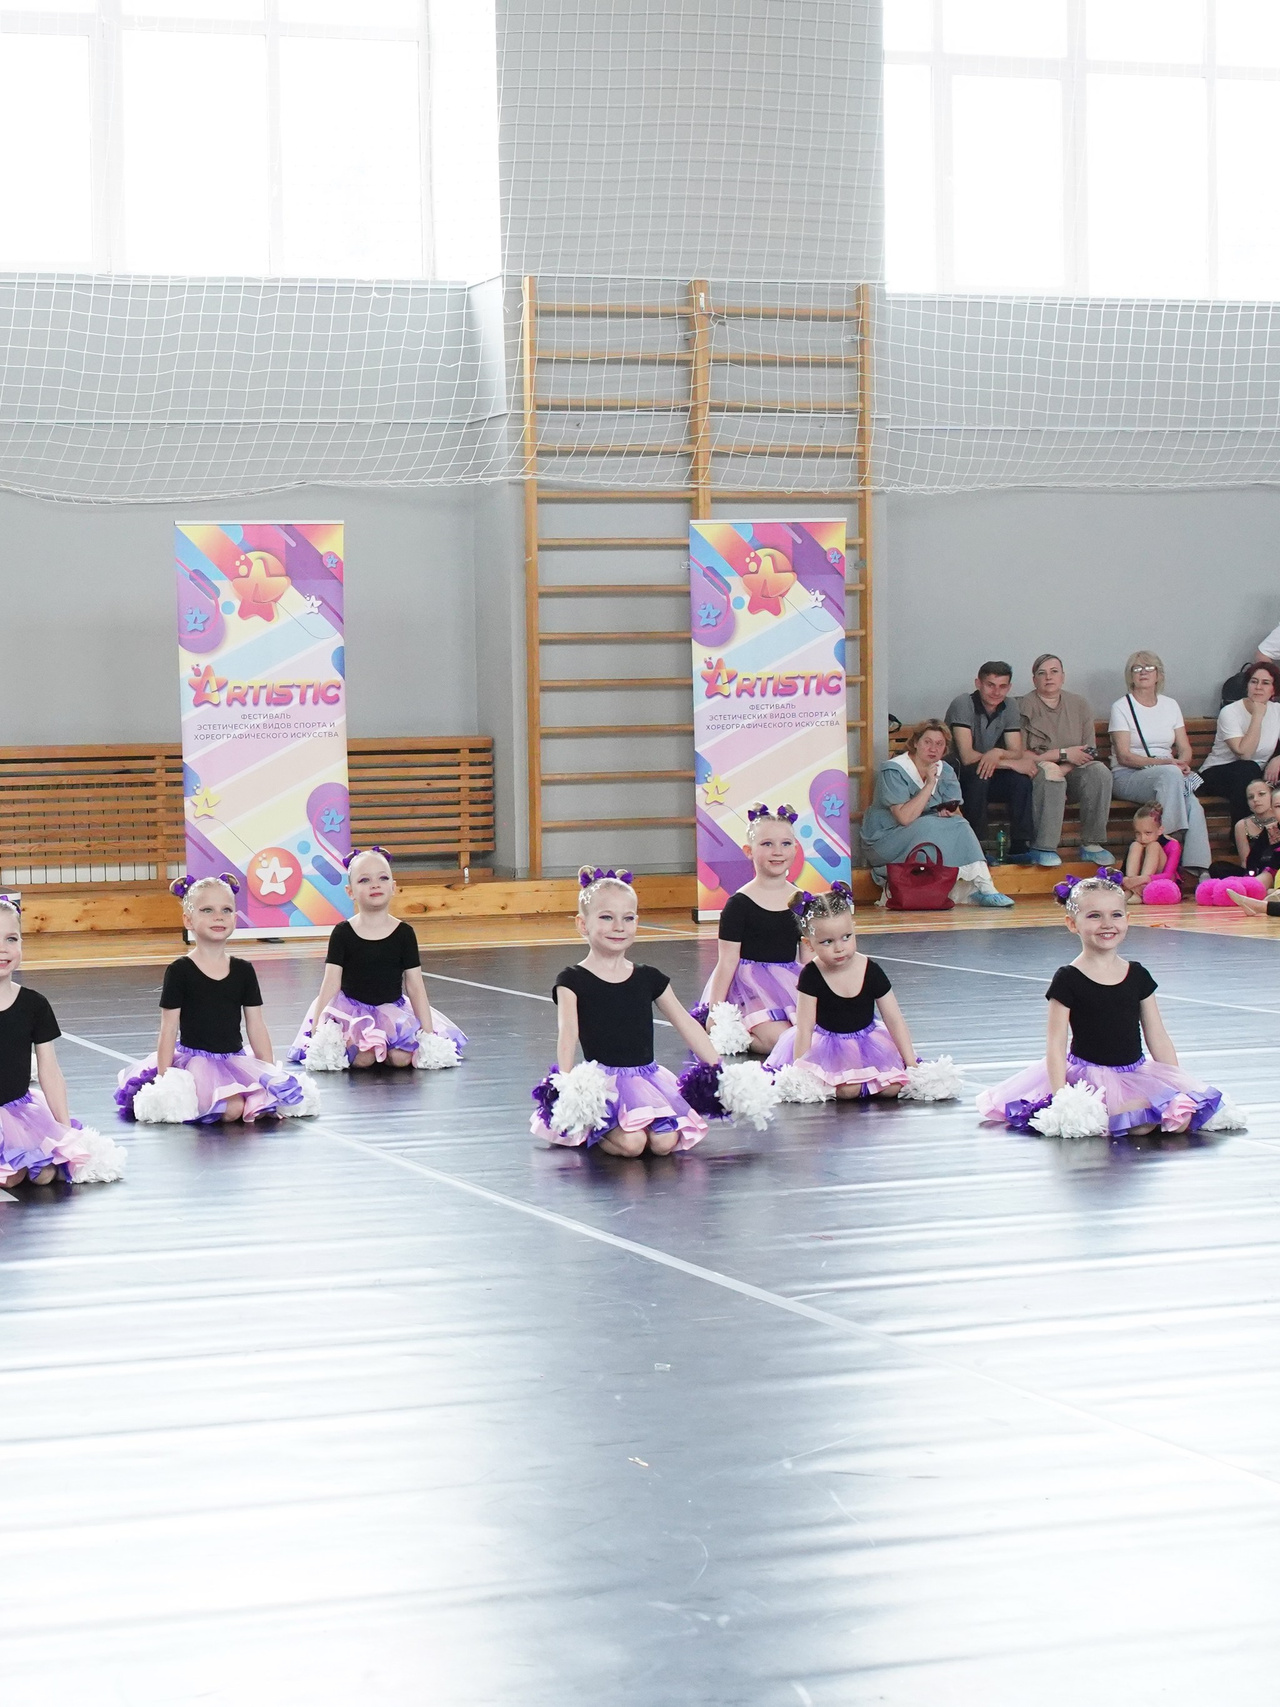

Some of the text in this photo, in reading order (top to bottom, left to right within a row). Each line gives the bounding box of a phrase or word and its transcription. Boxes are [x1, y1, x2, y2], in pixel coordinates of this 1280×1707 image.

[700, 657, 843, 699] ARTISTIC
[188, 664, 342, 708] ARTISTIC
[709, 713, 767, 721] ЭСТЕТИЧЕСКИХ
[769, 712, 796, 720] ВИДОВ
[197, 723, 261, 731] ЭСТЕТИЧЕСКИХ
[706, 720, 840, 731] ХОРЕОГРАФИЧЕСКОГО ИСКУССТВА
[194, 731, 339, 741] ХОРЕОГРАФИЧЕСКОГО ИСКУССТВА
